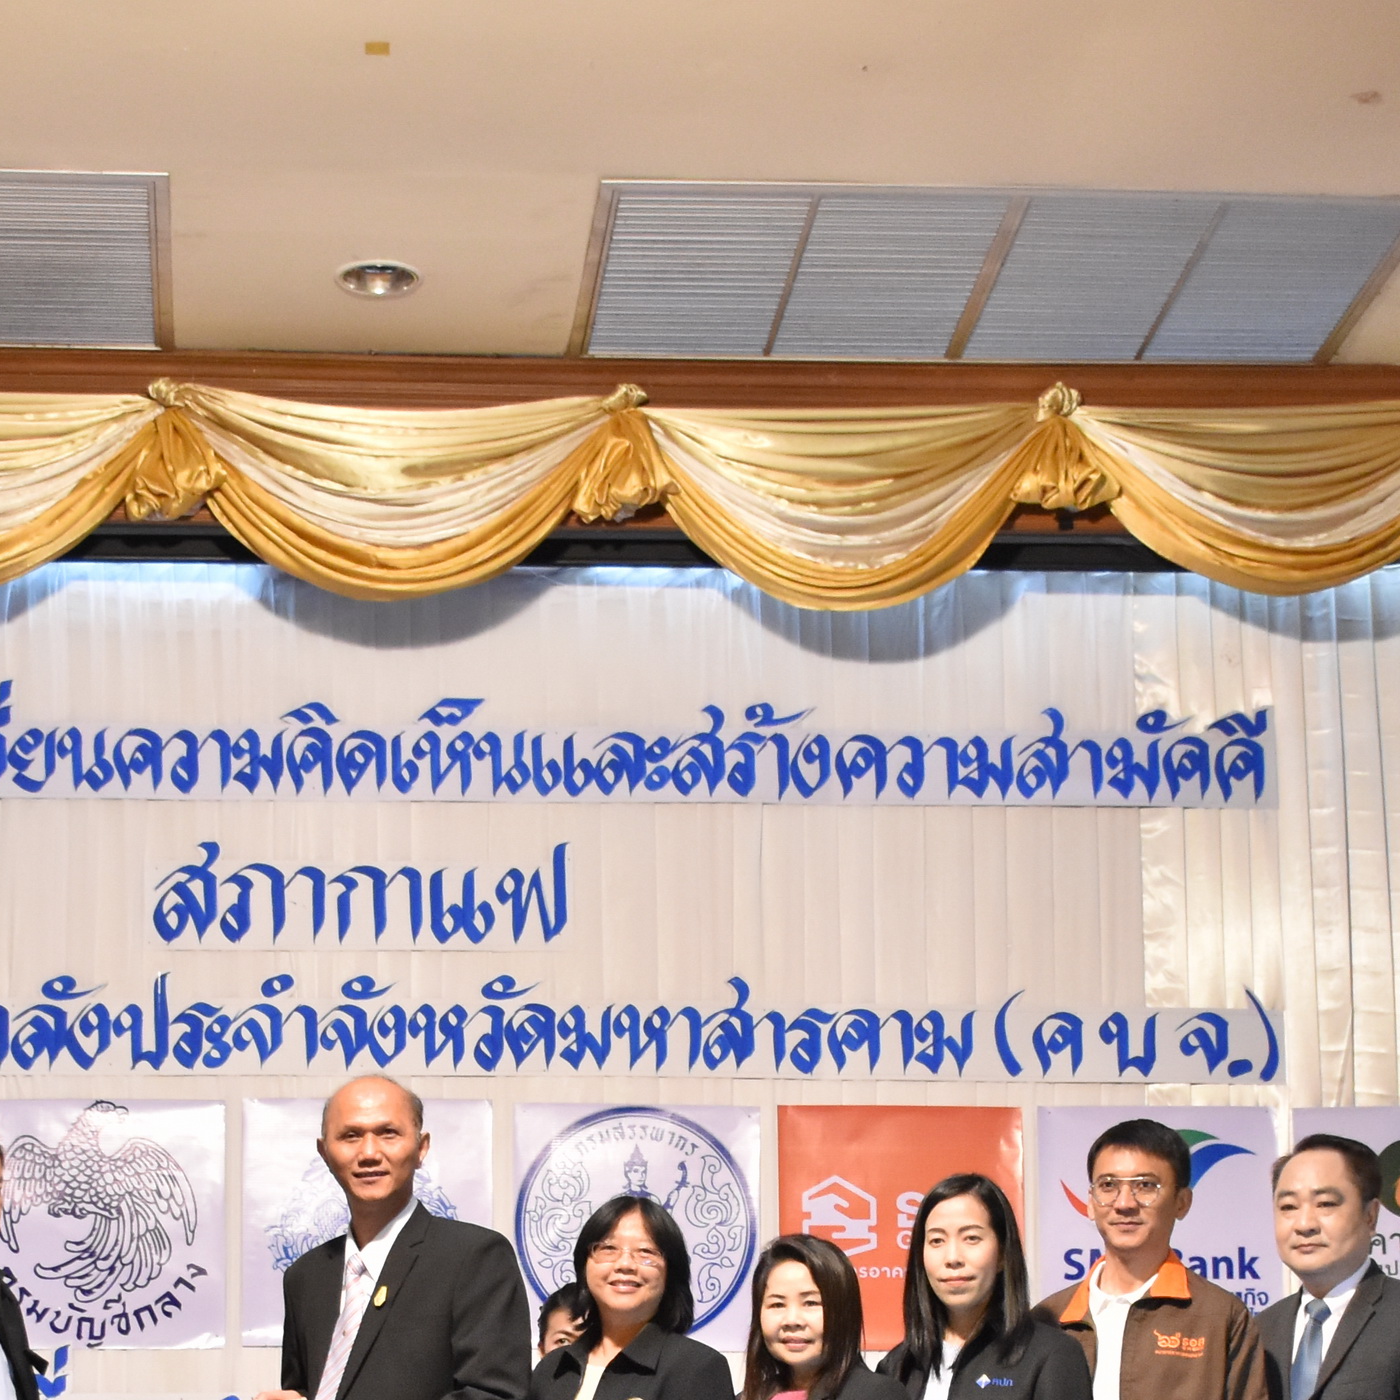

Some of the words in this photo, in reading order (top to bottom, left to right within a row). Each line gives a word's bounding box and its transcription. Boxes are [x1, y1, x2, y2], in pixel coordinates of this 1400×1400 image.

[153, 842, 569, 946] สภากาแฟ
[574, 1122, 700, 1157] กรมสรรพากร
[1172, 1246, 1261, 1280] ank
